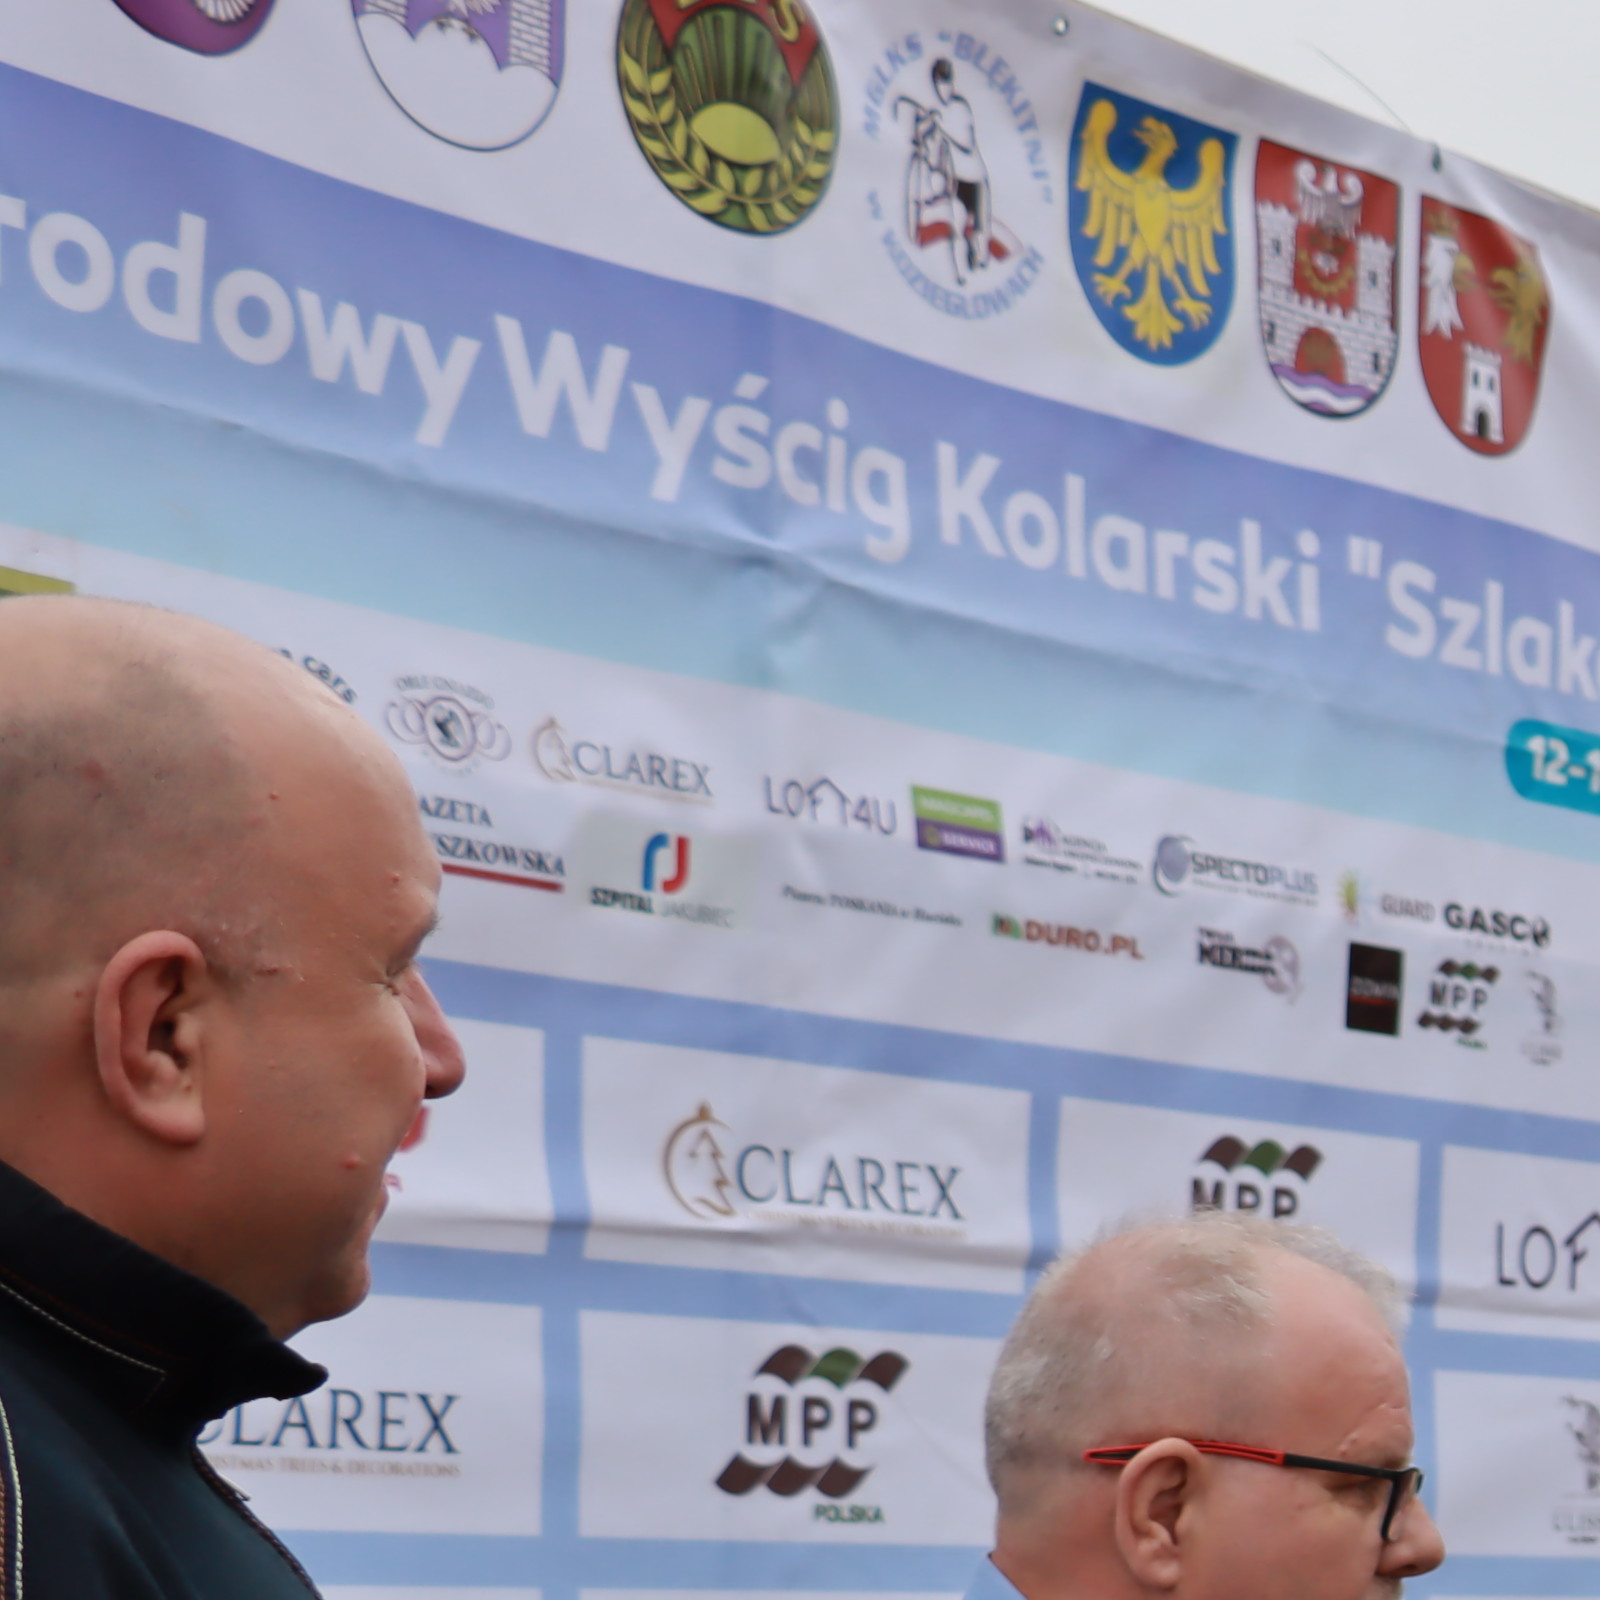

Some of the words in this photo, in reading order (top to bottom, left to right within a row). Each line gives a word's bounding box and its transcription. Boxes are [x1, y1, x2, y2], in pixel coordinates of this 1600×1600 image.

[0, 197, 482, 448] odowy
[494, 312, 911, 563] Wyścig
[935, 440, 1321, 632] Kolarski
[302, 650, 357, 704] cars
[573, 740, 714, 797] CLAREX
[764, 775, 898, 836] LOFT4U
[1191, 851, 1319, 895] SPECTOPLUS
[735, 1144, 966, 1221] CLAREX
[746, 1393, 878, 1450] MPP
[813, 1503, 884, 1524] POLSKA
